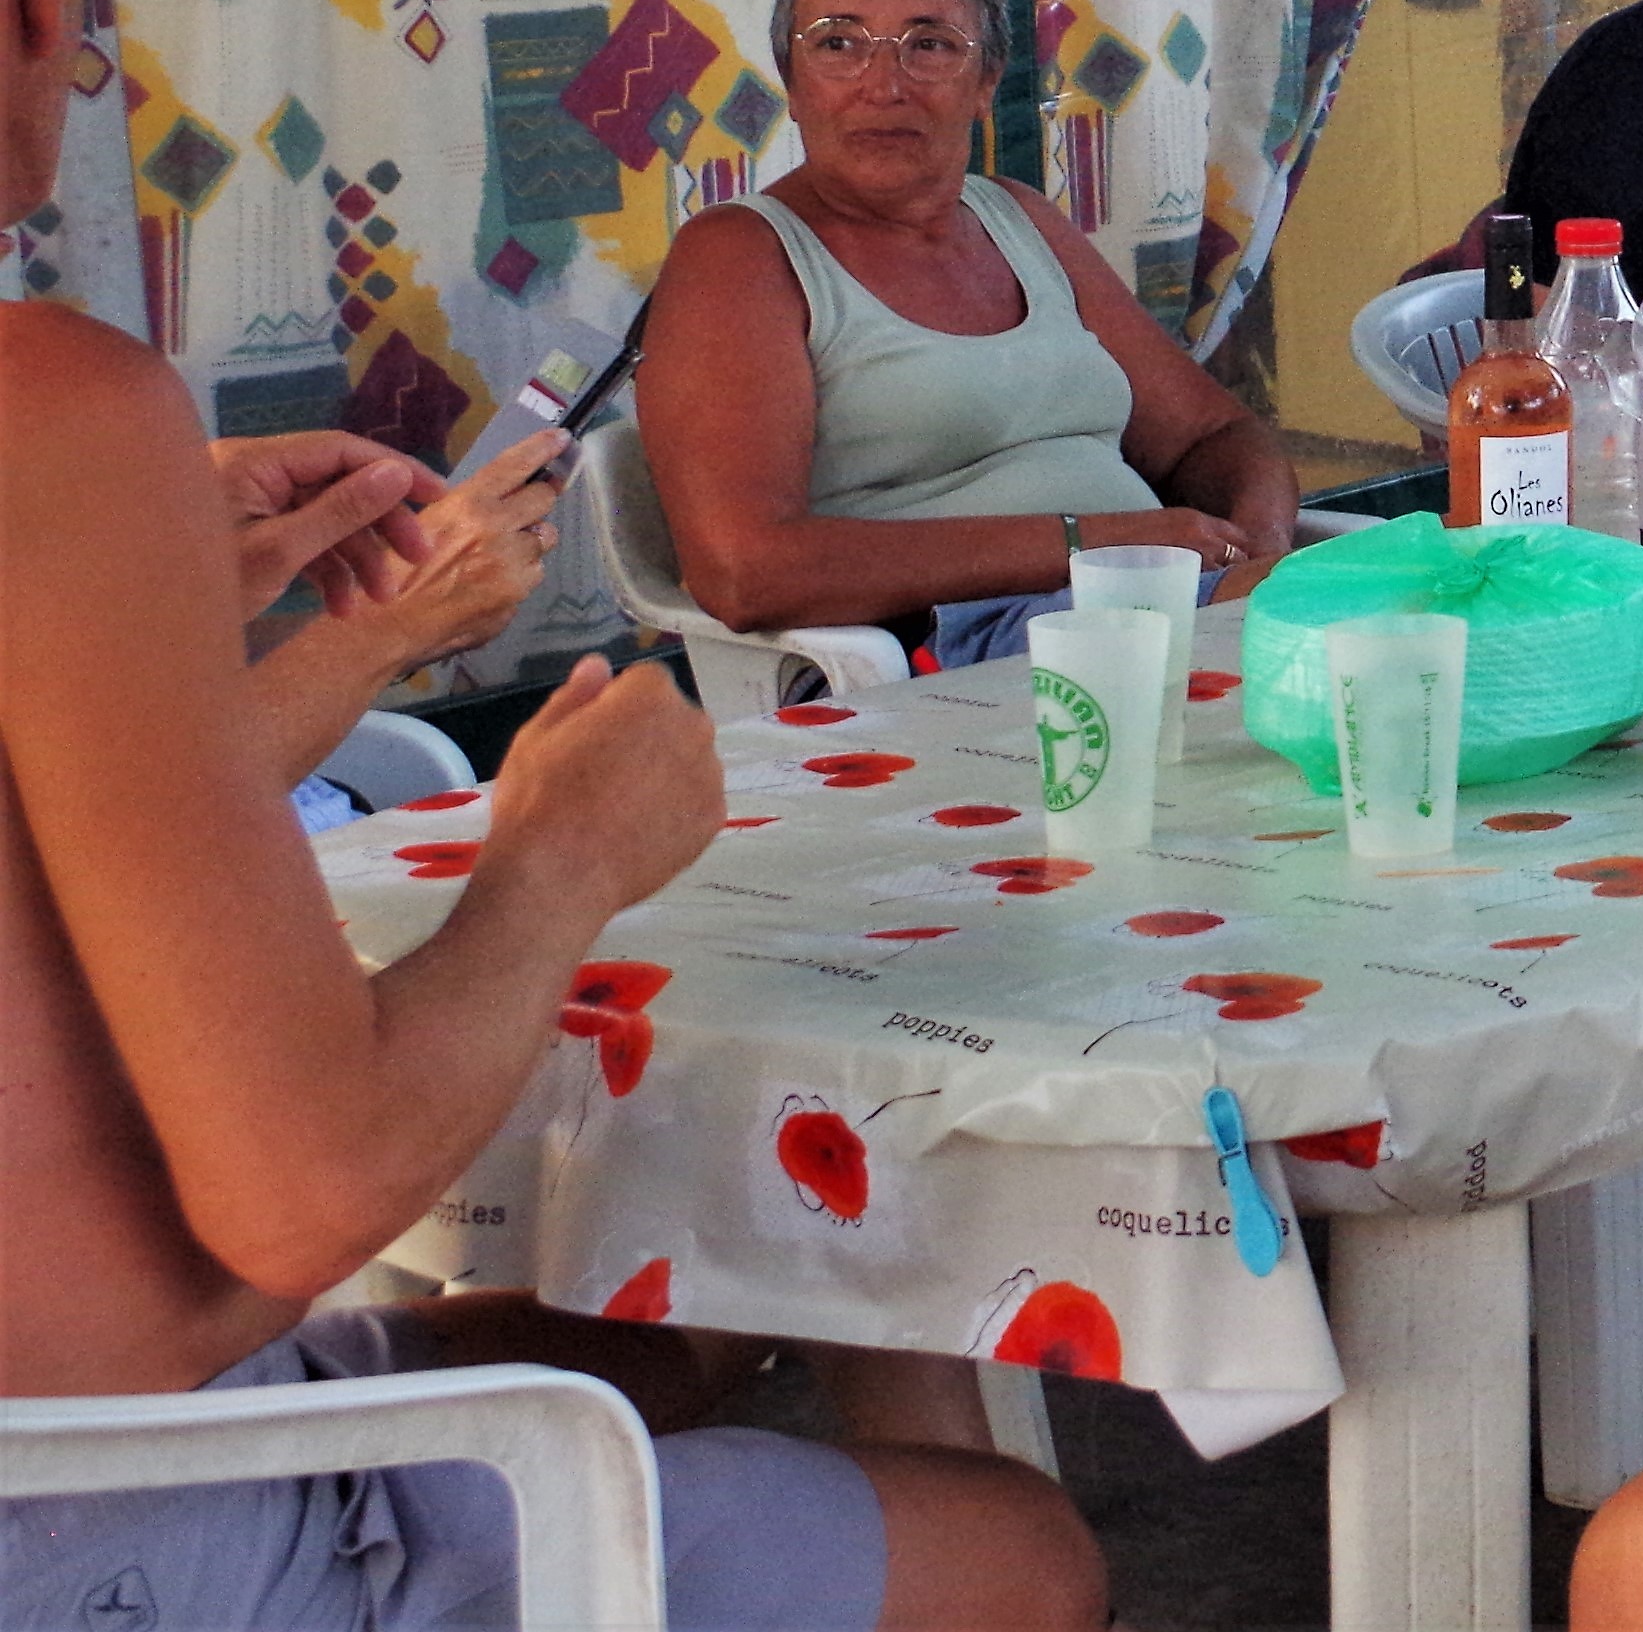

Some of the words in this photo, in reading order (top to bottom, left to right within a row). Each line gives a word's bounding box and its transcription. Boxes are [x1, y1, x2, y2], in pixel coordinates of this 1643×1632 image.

[1518, 470, 1541, 490] Les
[1490, 487, 1563, 518] Olianes
[882, 1010, 996, 1054] poppies
